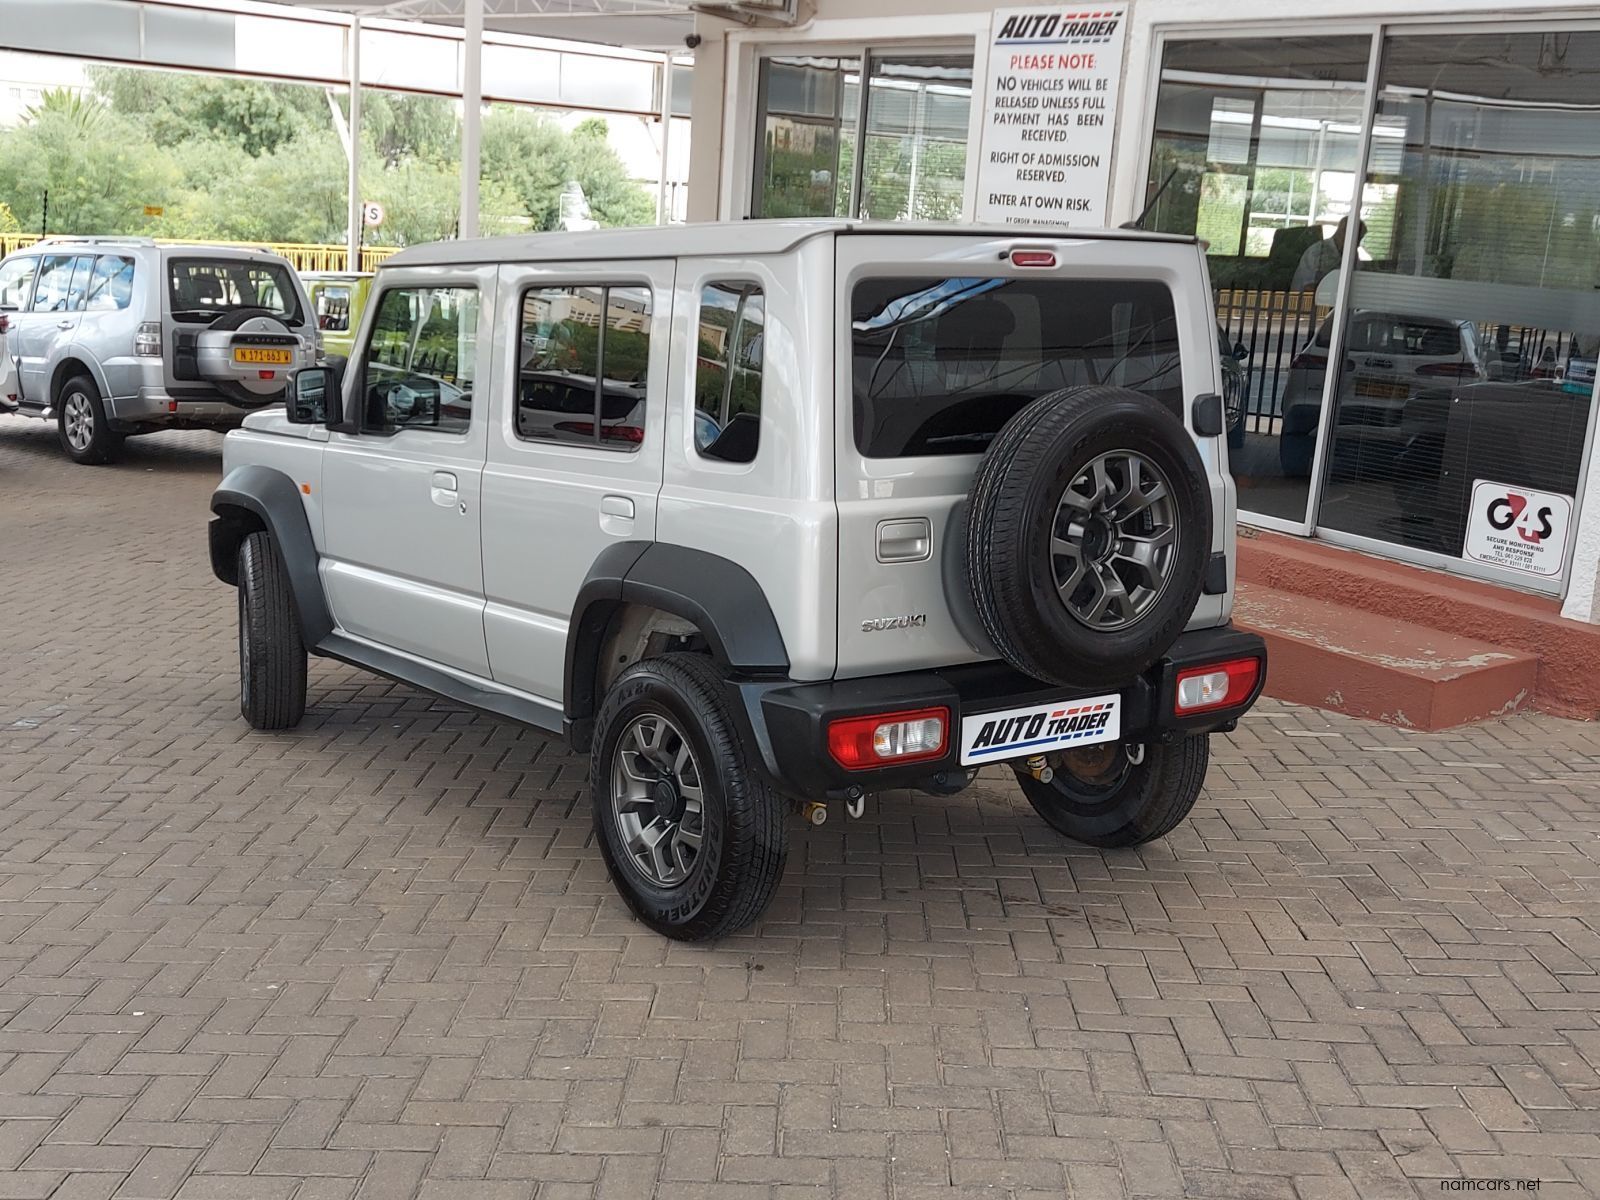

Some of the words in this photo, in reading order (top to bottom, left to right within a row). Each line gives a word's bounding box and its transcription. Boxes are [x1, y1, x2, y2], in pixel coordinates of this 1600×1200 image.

[998, 14, 1062, 39] AUTO
[1059, 20, 1119, 38] TRADER
[1010, 54, 1055, 70] PLEASE
[996, 76, 1017, 91] NO
[1020, 78, 1064, 91] VEHICLES
[1068, 79, 1091, 91] WILL
[1095, 79, 1108, 91] BE
[995, 96, 1039, 109] RELEASED
[1042, 97, 1079, 109] UNLESS
[1082, 97, 1106, 109] FULL
[993, 113, 1040, 125] PAYMENT
[1047, 113, 1069, 126] HAS
[1076, 114, 1104, 126] BEEN
[990, 151, 1020, 165] RIGHT
[1021, 153, 1036, 165] OF
[1037, 154, 1100, 168] ADMISSION
[989, 193, 1017, 207] ENTER
[1019, 196, 1033, 208] AT
[1034, 196, 1063, 210] OWN
[369, 207, 378, 220] S
[240, 350, 246, 360] N
[284, 352, 289, 362] W
[1486, 493, 1553, 544] G4S
[1486, 535, 1508, 546] SECURE
[1508, 540, 1545, 553] MONITORING
[1492, 544, 1505, 552] AND
[1505, 547, 1535, 558] RESPONSE
[1494, 550, 1504, 558] TEL
[861, 614, 927, 633] SUZUKI
[971, 713, 1048, 749] AUTO
[1046, 711, 1111, 736] TRADER
